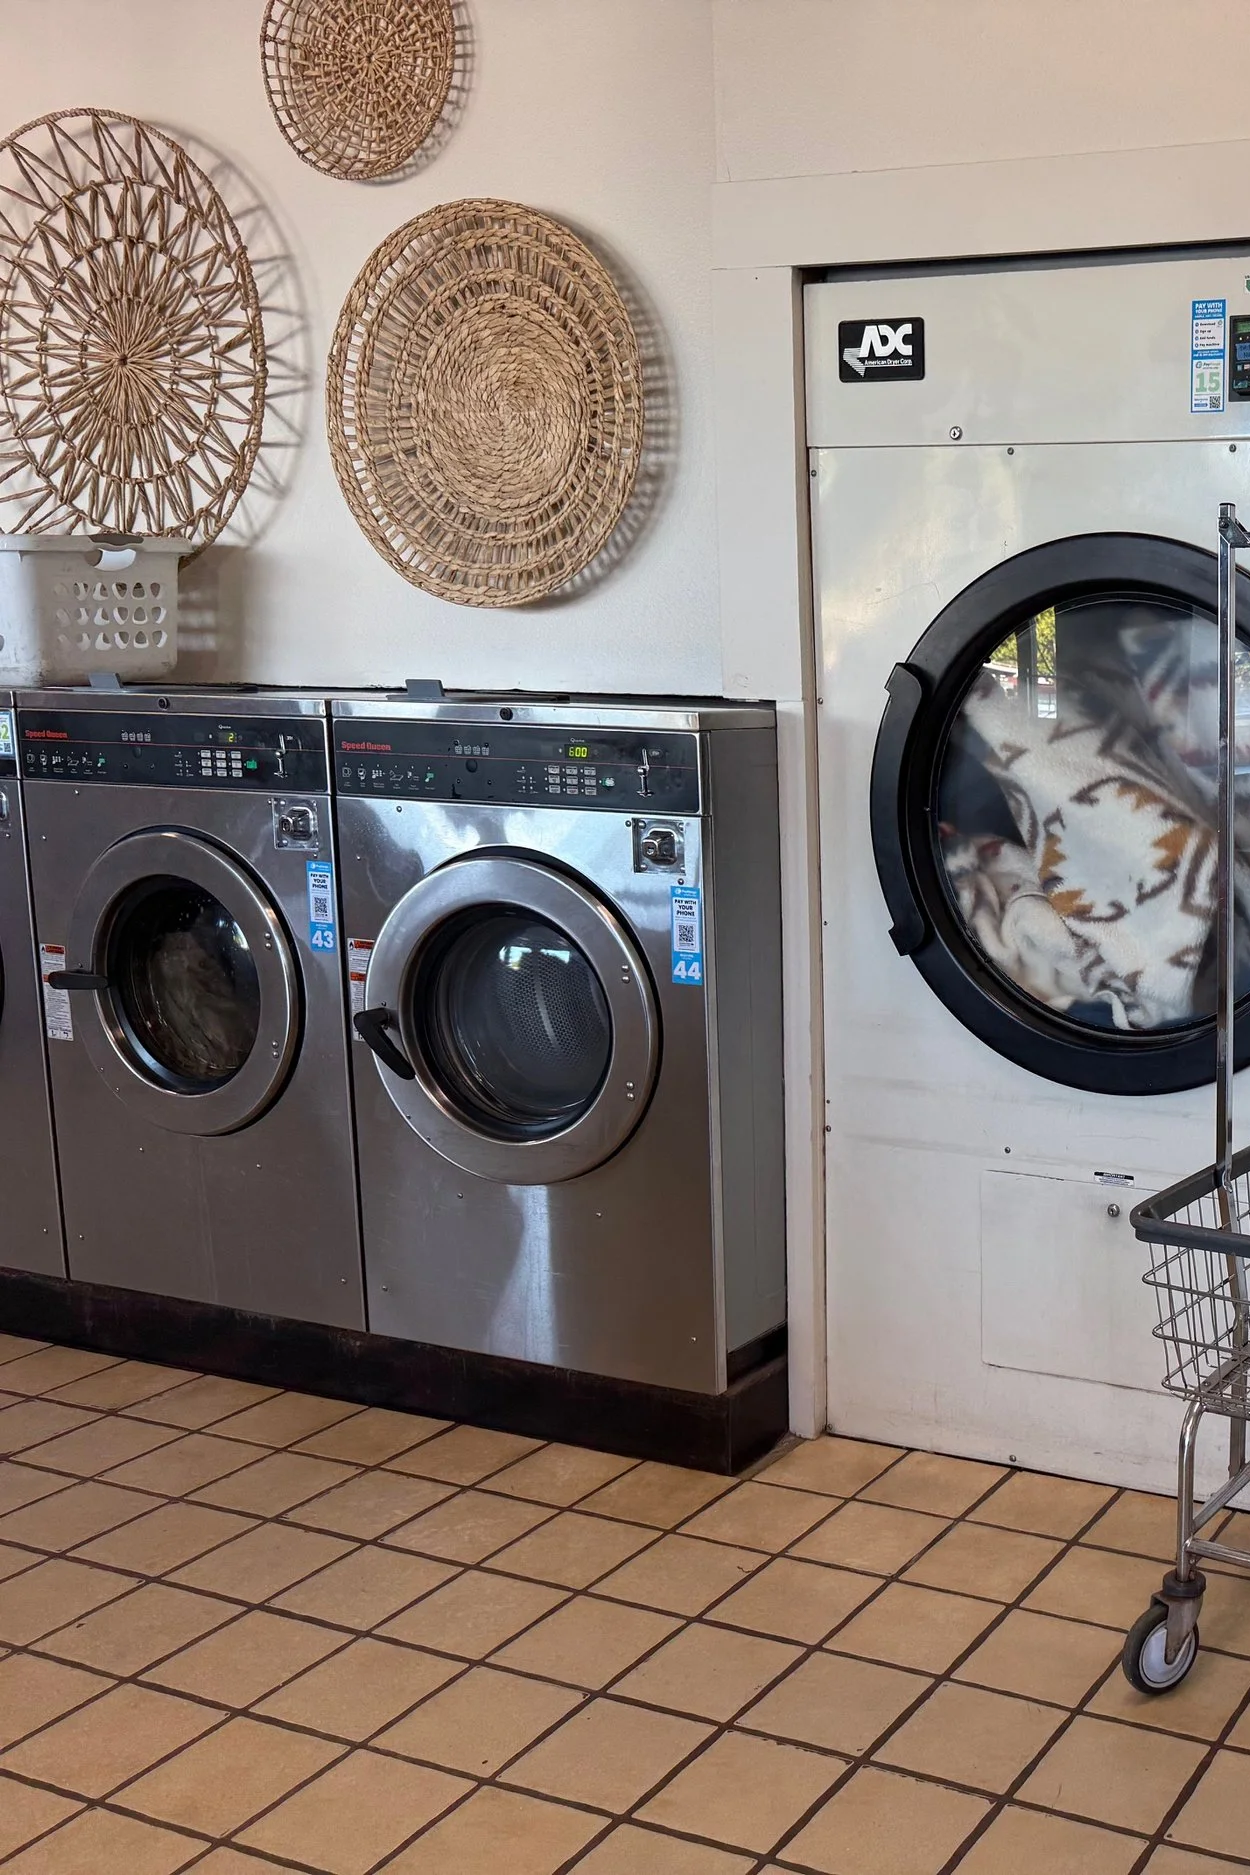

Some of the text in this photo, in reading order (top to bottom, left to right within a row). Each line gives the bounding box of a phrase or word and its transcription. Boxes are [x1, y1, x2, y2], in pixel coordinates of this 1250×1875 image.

[859, 324, 912, 357] ADC
[1196, 372, 1220, 392] 15
[25, 730, 68, 738] Speed Queen
[342, 741, 391, 751] Speed Queen
[312, 930, 334, 948] 43
[674, 961, 701, 980] 44
